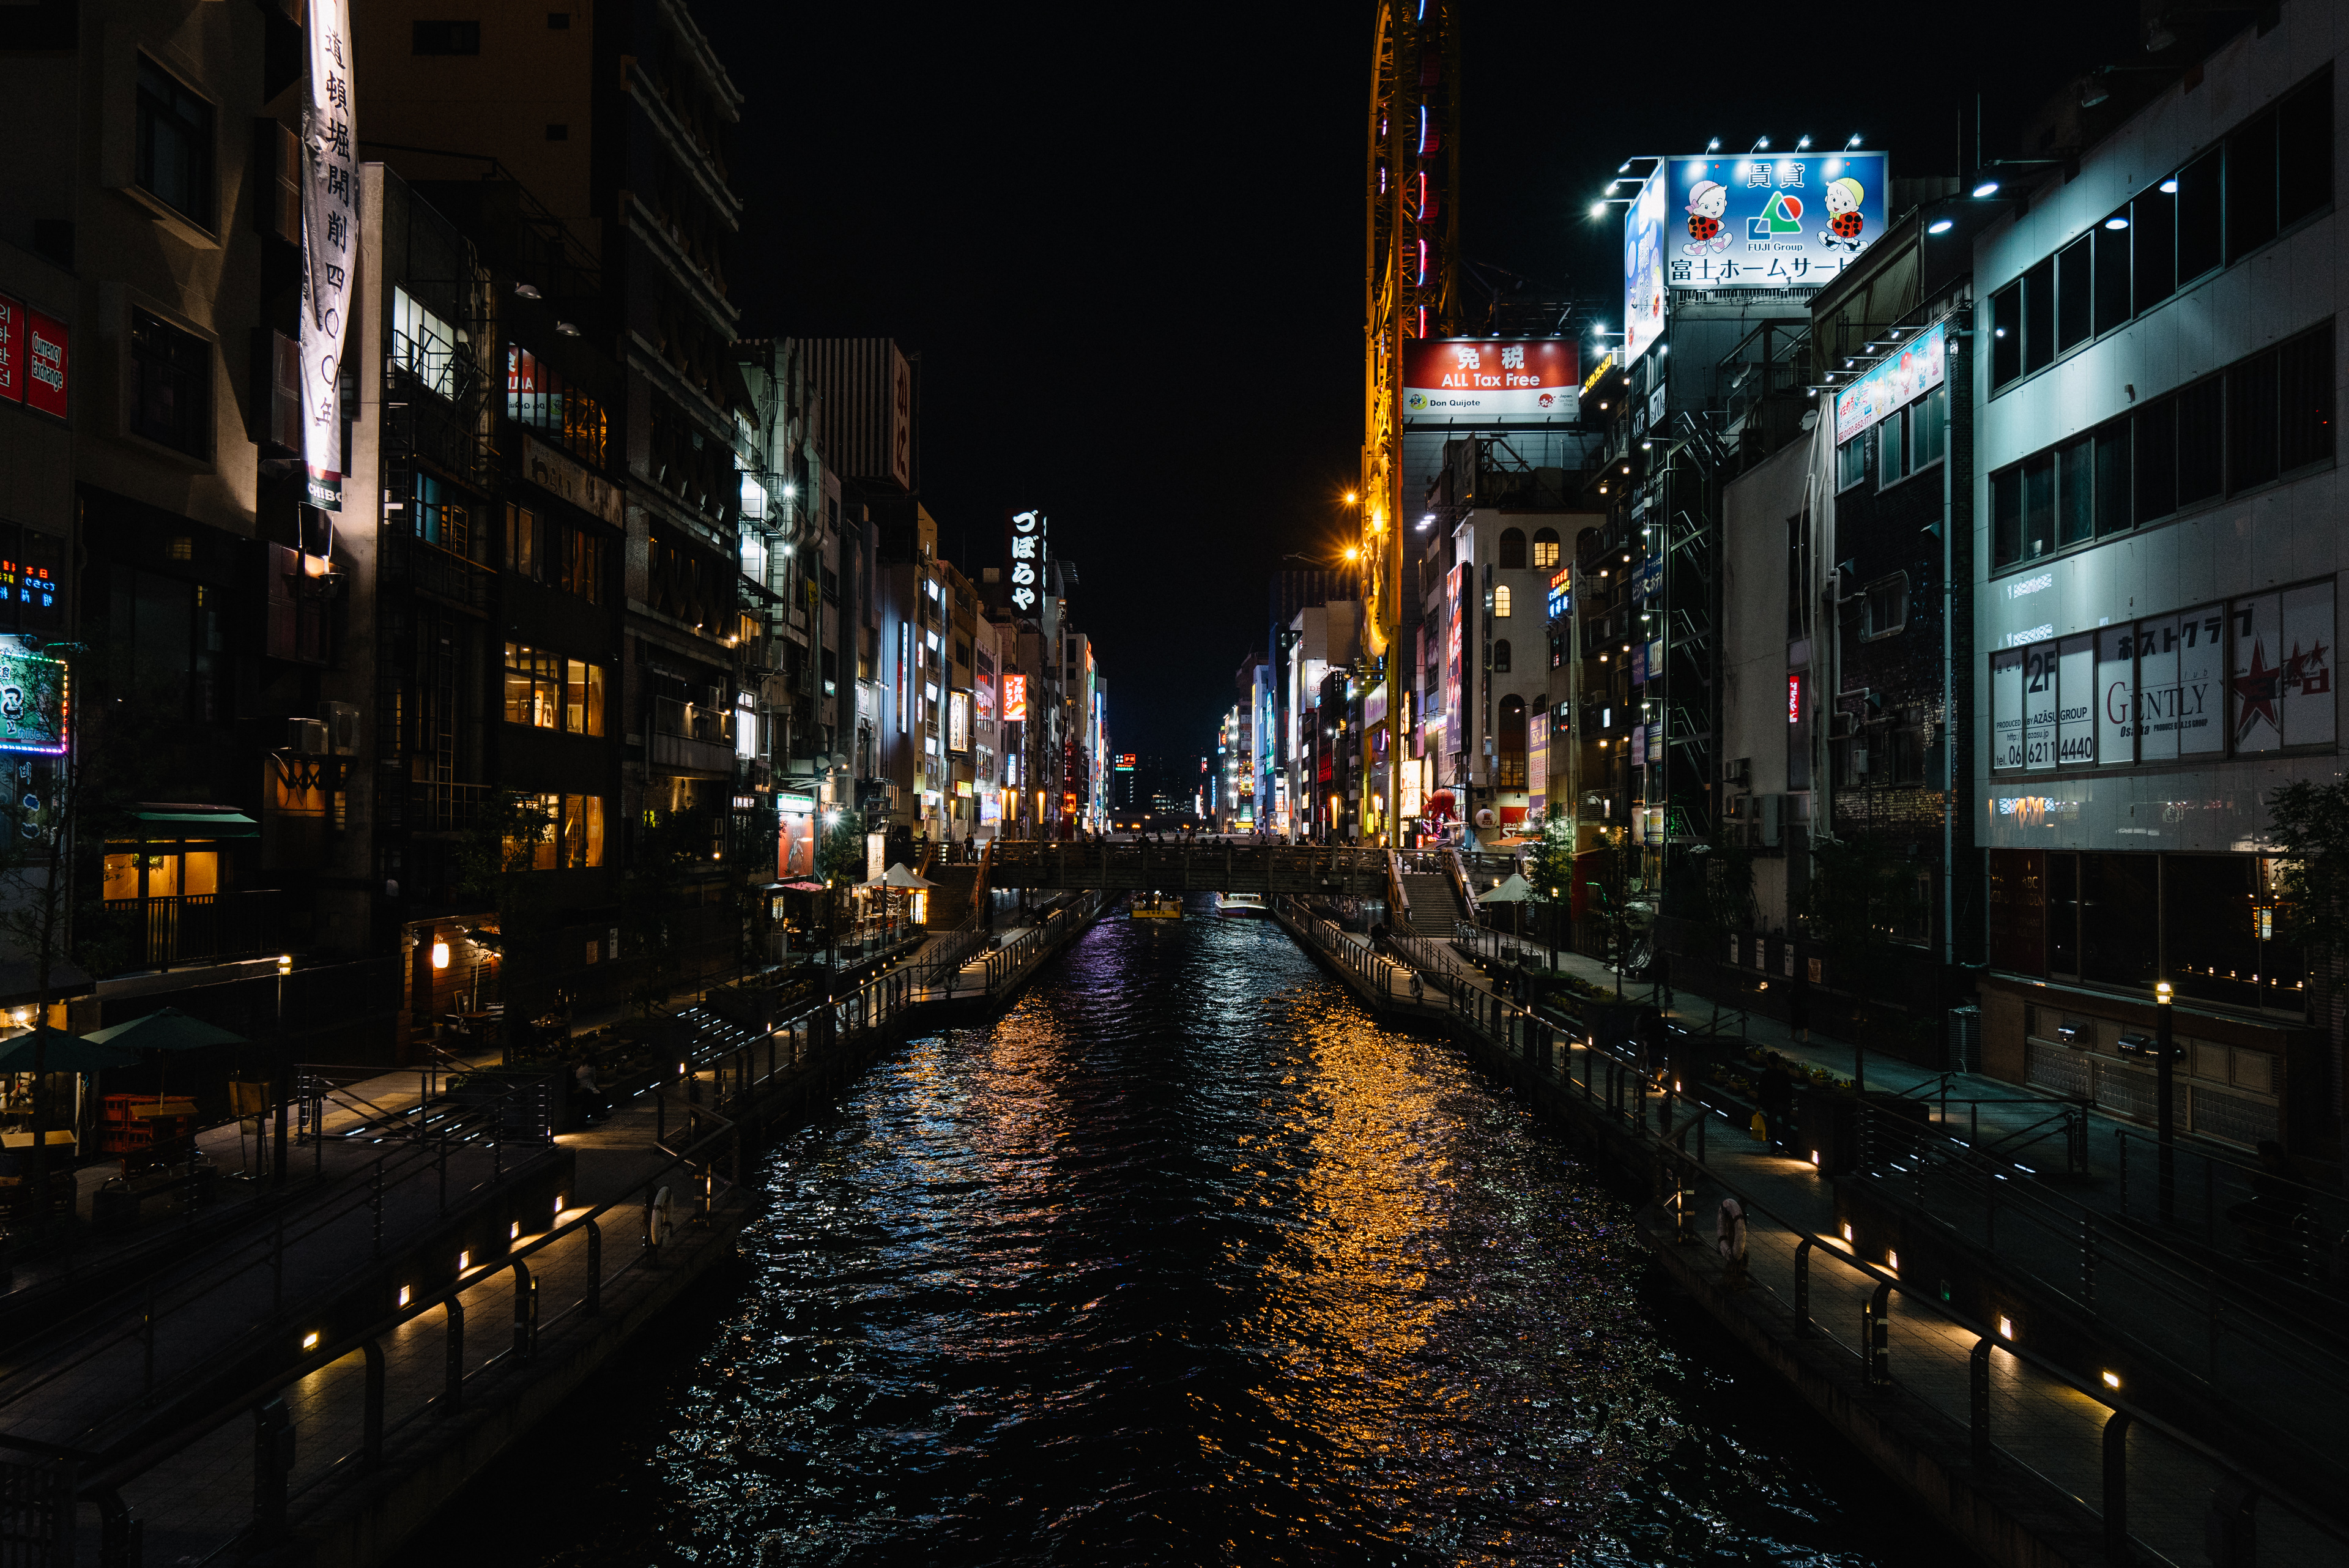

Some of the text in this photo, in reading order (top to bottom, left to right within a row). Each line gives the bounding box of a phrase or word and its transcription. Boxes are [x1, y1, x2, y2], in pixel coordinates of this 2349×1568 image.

[1746, 163, 1805, 188] 賃貸
[1748, 242, 1803, 253] FUJI Group
[33, 331, 62, 368] Currency
[1458, 347, 1524, 370] 免税
[32, 355, 62, 392] Exchange
[1442, 373, 1540, 387] ALL Tax Free
[1450, 399, 1480, 407] Quijote
[1632, 413, 1645, 438] ALP
[1844, 414, 1872, 437] 0120-952-177
[1012, 510, 1039, 611] づぼらや
[2118, 603, 2254, 660] ホストクラブ
[2028, 651, 2055, 693] 2F
[1005, 681, 1014, 709] ドラッグ
[1014, 677, 1024, 702] ツルハ
[1997, 719, 2021, 729] PRODUCED
[2060, 707, 2087, 721] GROUP
[2192, 718, 2208, 727] GROUP
[1997, 737, 2093, 765] tel. 06 6211 4440
[2022, 875, 2038, 889] ABC
